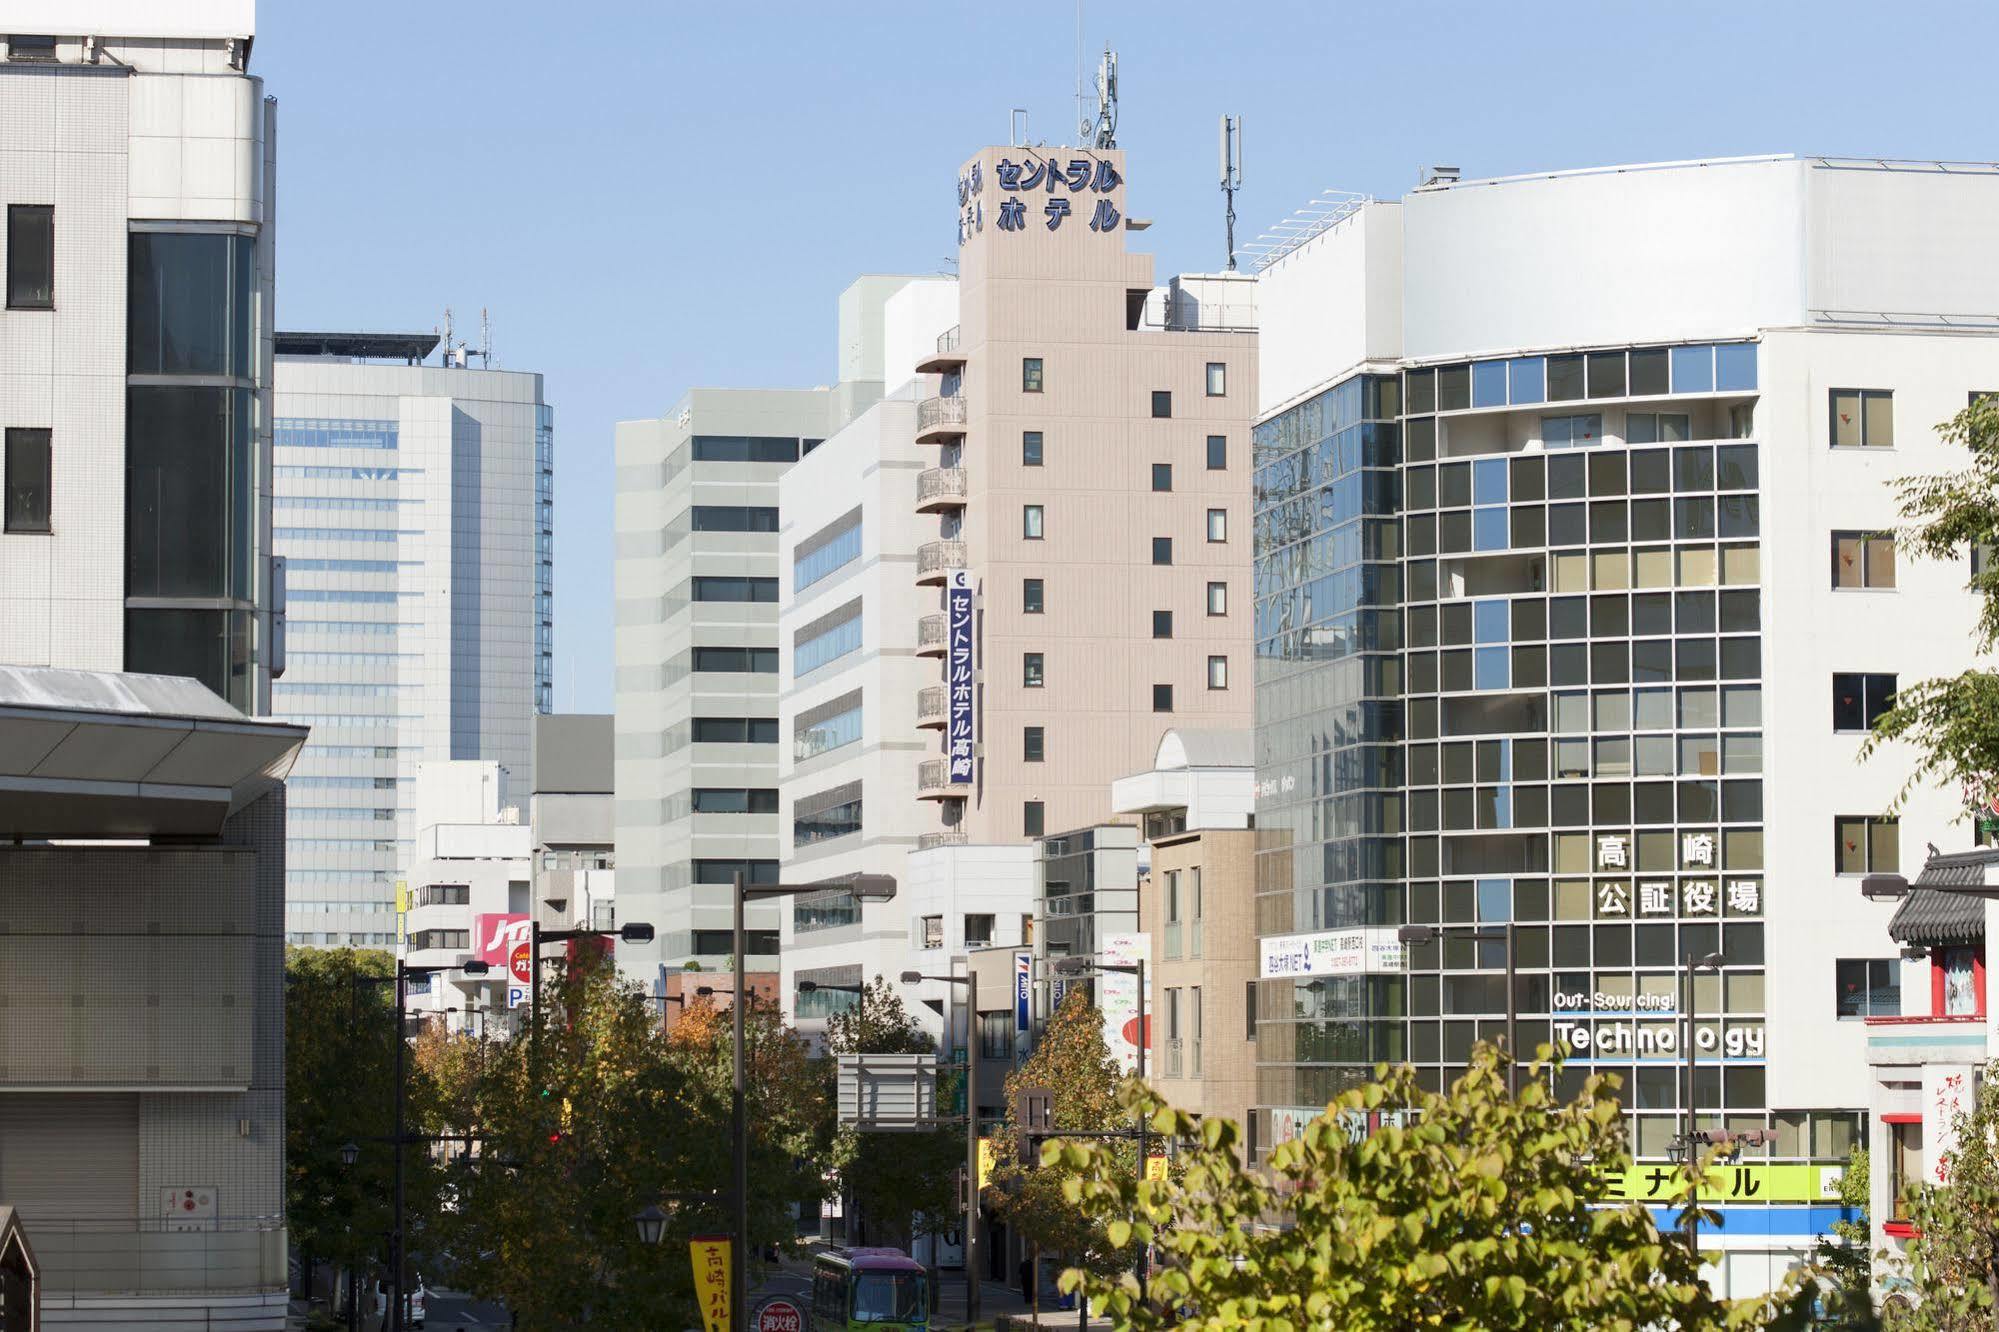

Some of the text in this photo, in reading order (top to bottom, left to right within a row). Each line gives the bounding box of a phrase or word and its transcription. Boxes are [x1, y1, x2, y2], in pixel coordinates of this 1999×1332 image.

[996, 158, 1121, 193] セントラル
[996, 196, 1121, 232] ホテル
[1597, 833, 1714, 867] 高崎
[1598, 880, 1759, 913] 公証役場
[510, 988, 523, 1007] P
[1554, 1022, 1765, 1057] Technology
[705, 1246, 728, 1319] 高崎バル
[763, 1314, 798, 1332] 消火栓
